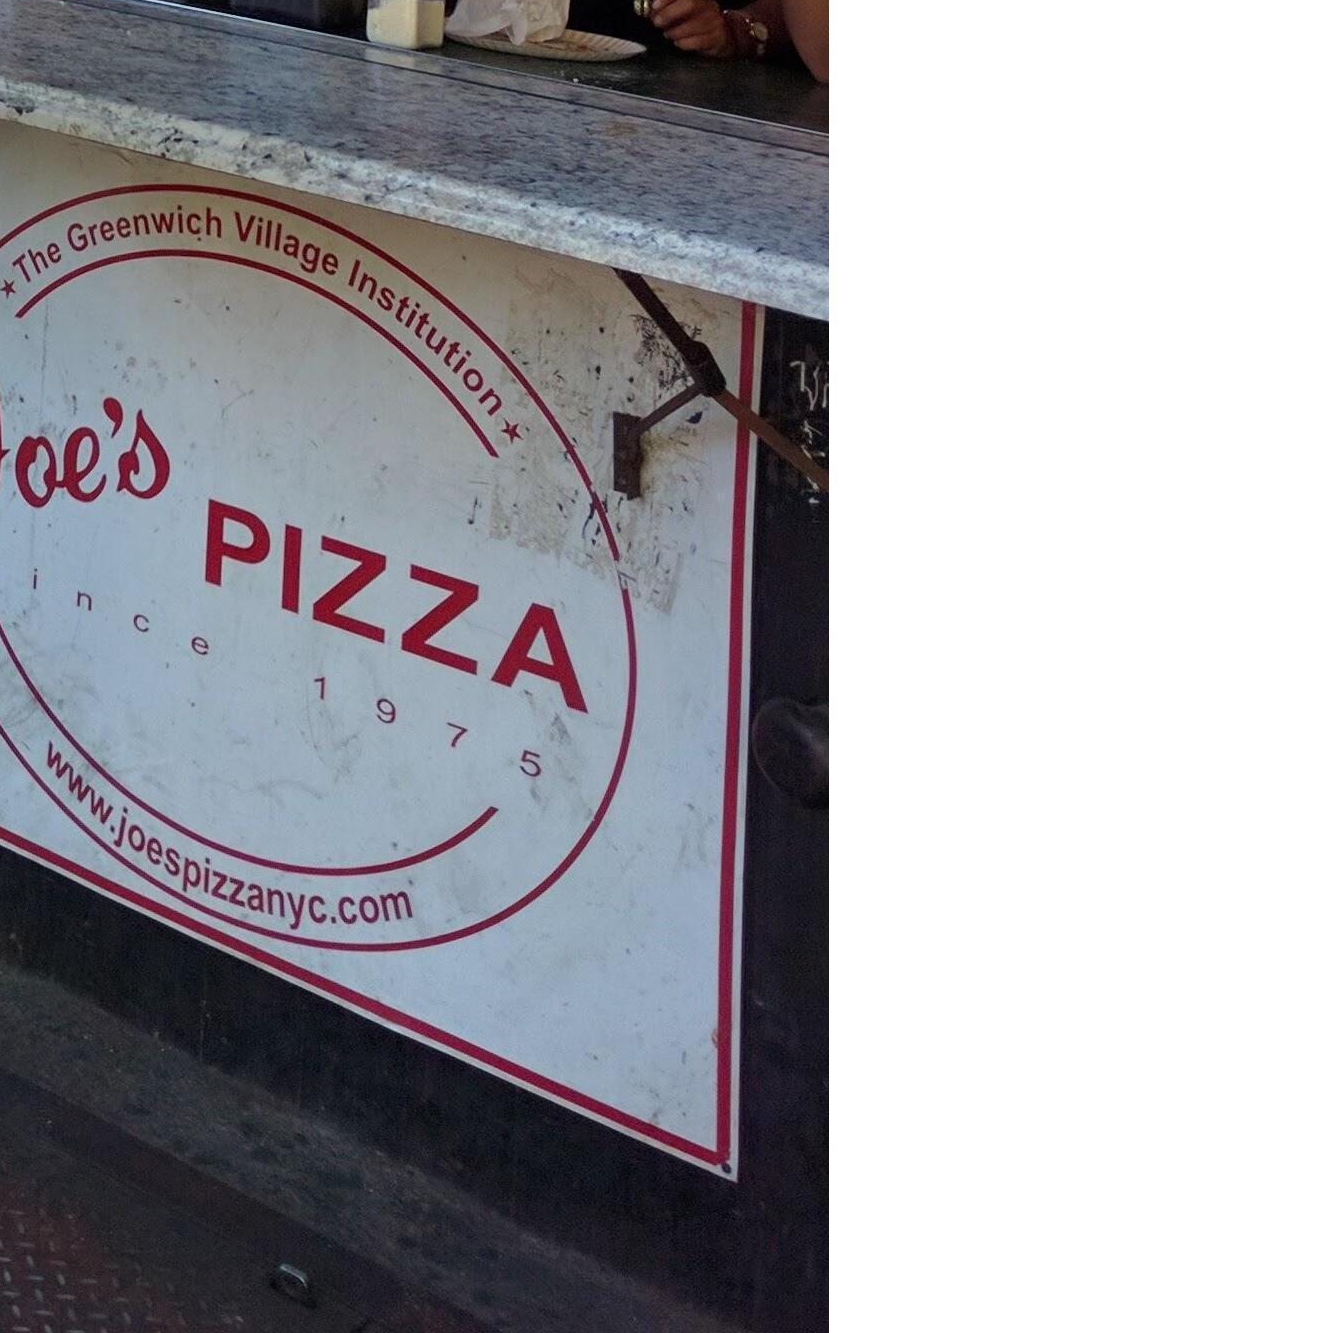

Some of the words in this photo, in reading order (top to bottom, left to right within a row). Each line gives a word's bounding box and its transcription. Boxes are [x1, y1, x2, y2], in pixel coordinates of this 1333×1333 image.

[12, 242, 62, 284] The
[67, 205, 223, 254] Greenwich
[233, 210, 339, 276] Village
[348, 259, 504, 418] Institution
[205, 499, 589, 715] PIZZA
[313, 676, 543, 778] 1975
[47, 739, 414, 930] www.joespizzanyc.com
